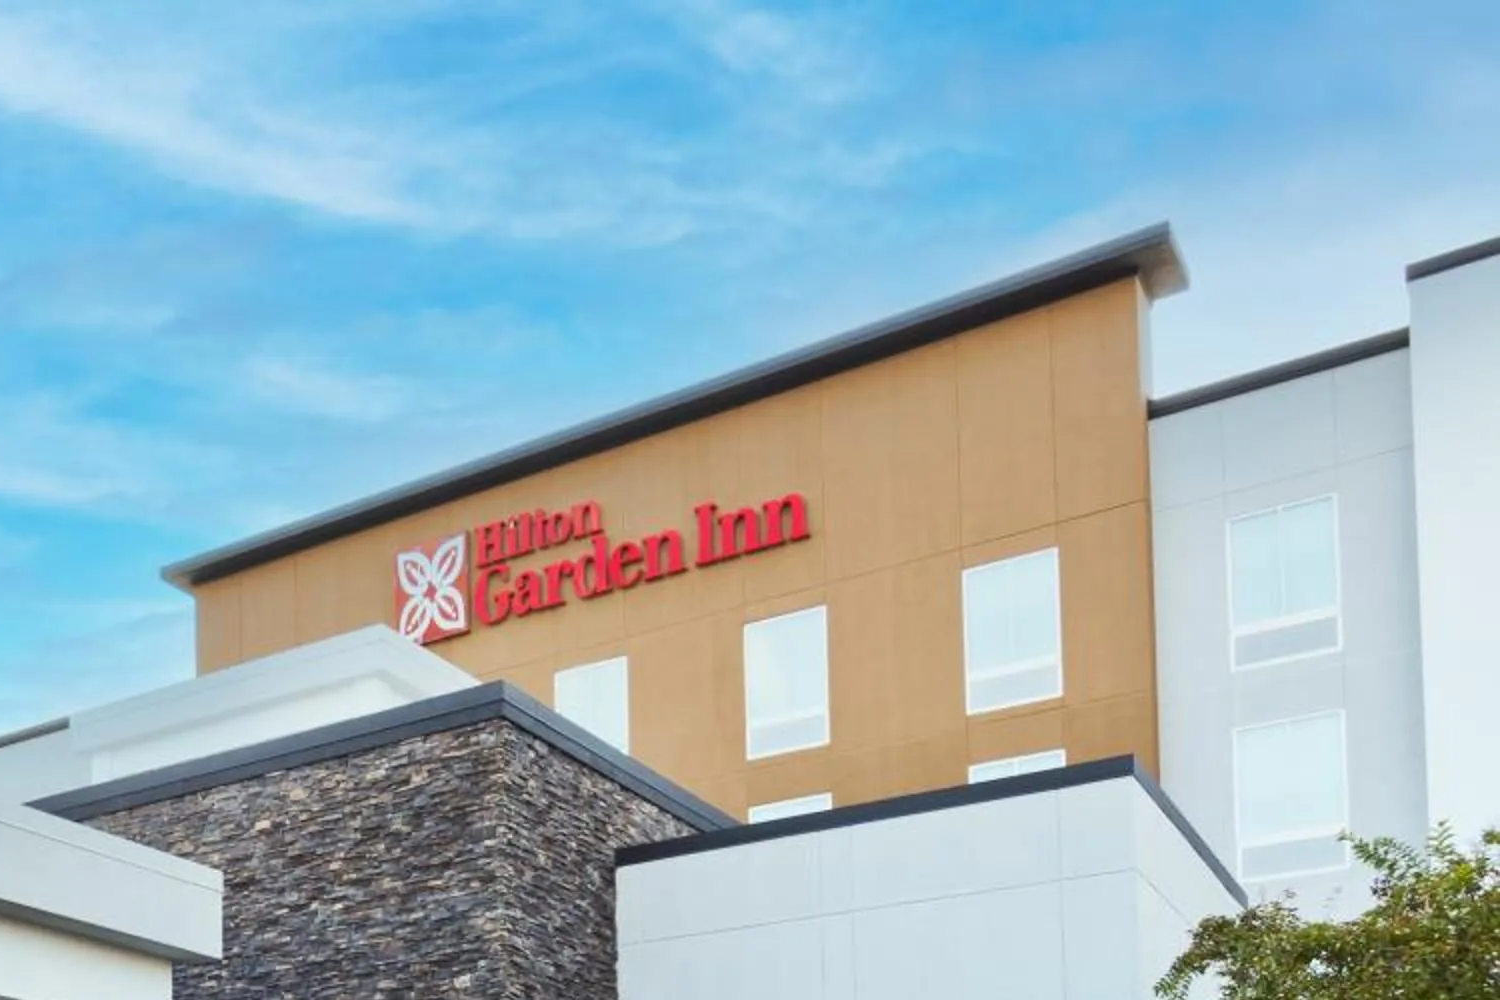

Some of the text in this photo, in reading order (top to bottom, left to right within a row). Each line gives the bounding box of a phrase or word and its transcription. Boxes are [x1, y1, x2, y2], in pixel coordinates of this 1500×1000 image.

[474, 492, 811, 626] Garden Inn
[476, 500, 603, 568] Hilton
